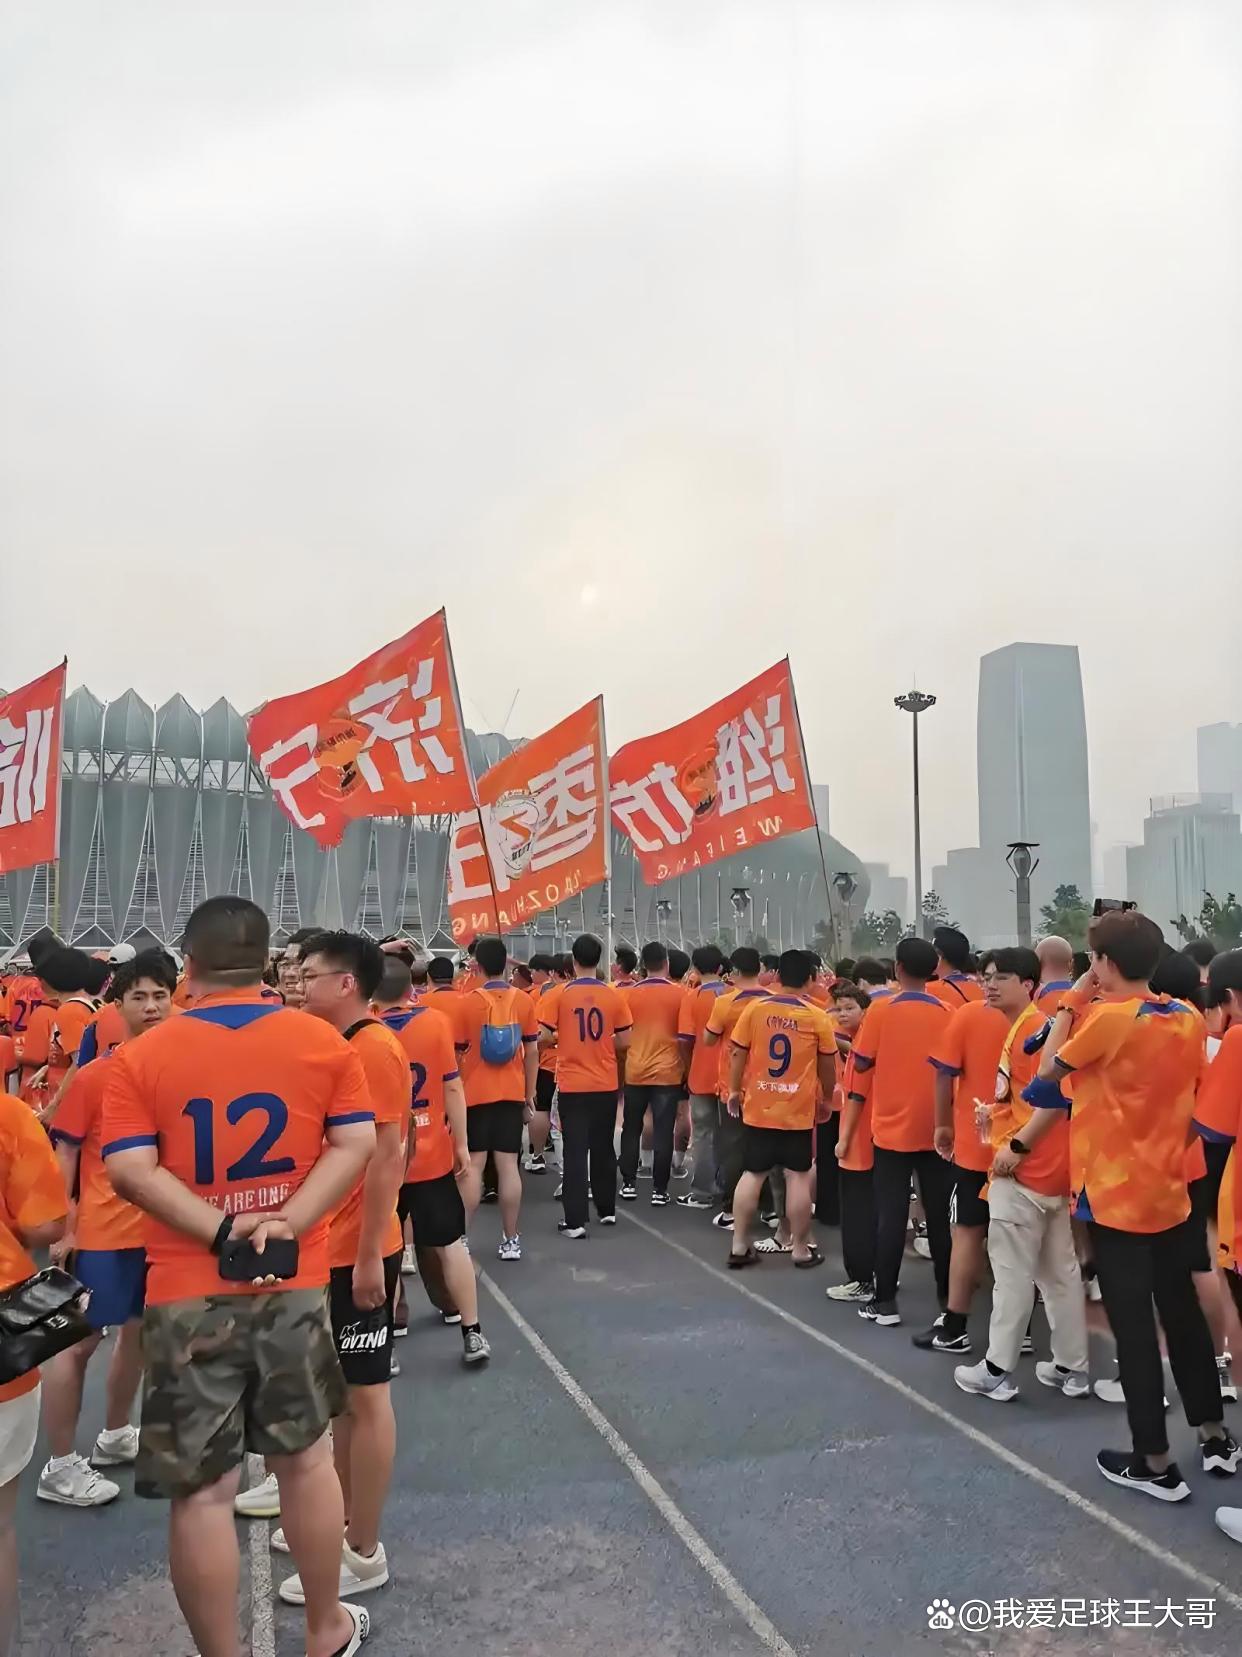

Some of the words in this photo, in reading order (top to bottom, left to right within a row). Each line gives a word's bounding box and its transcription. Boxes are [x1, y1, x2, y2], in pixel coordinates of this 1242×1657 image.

[574, 1007, 604, 1042] 10
[768, 1033, 792, 1077] 9
[181, 1092, 296, 1185] 12
[223, 1190, 256, 1217] ARE
